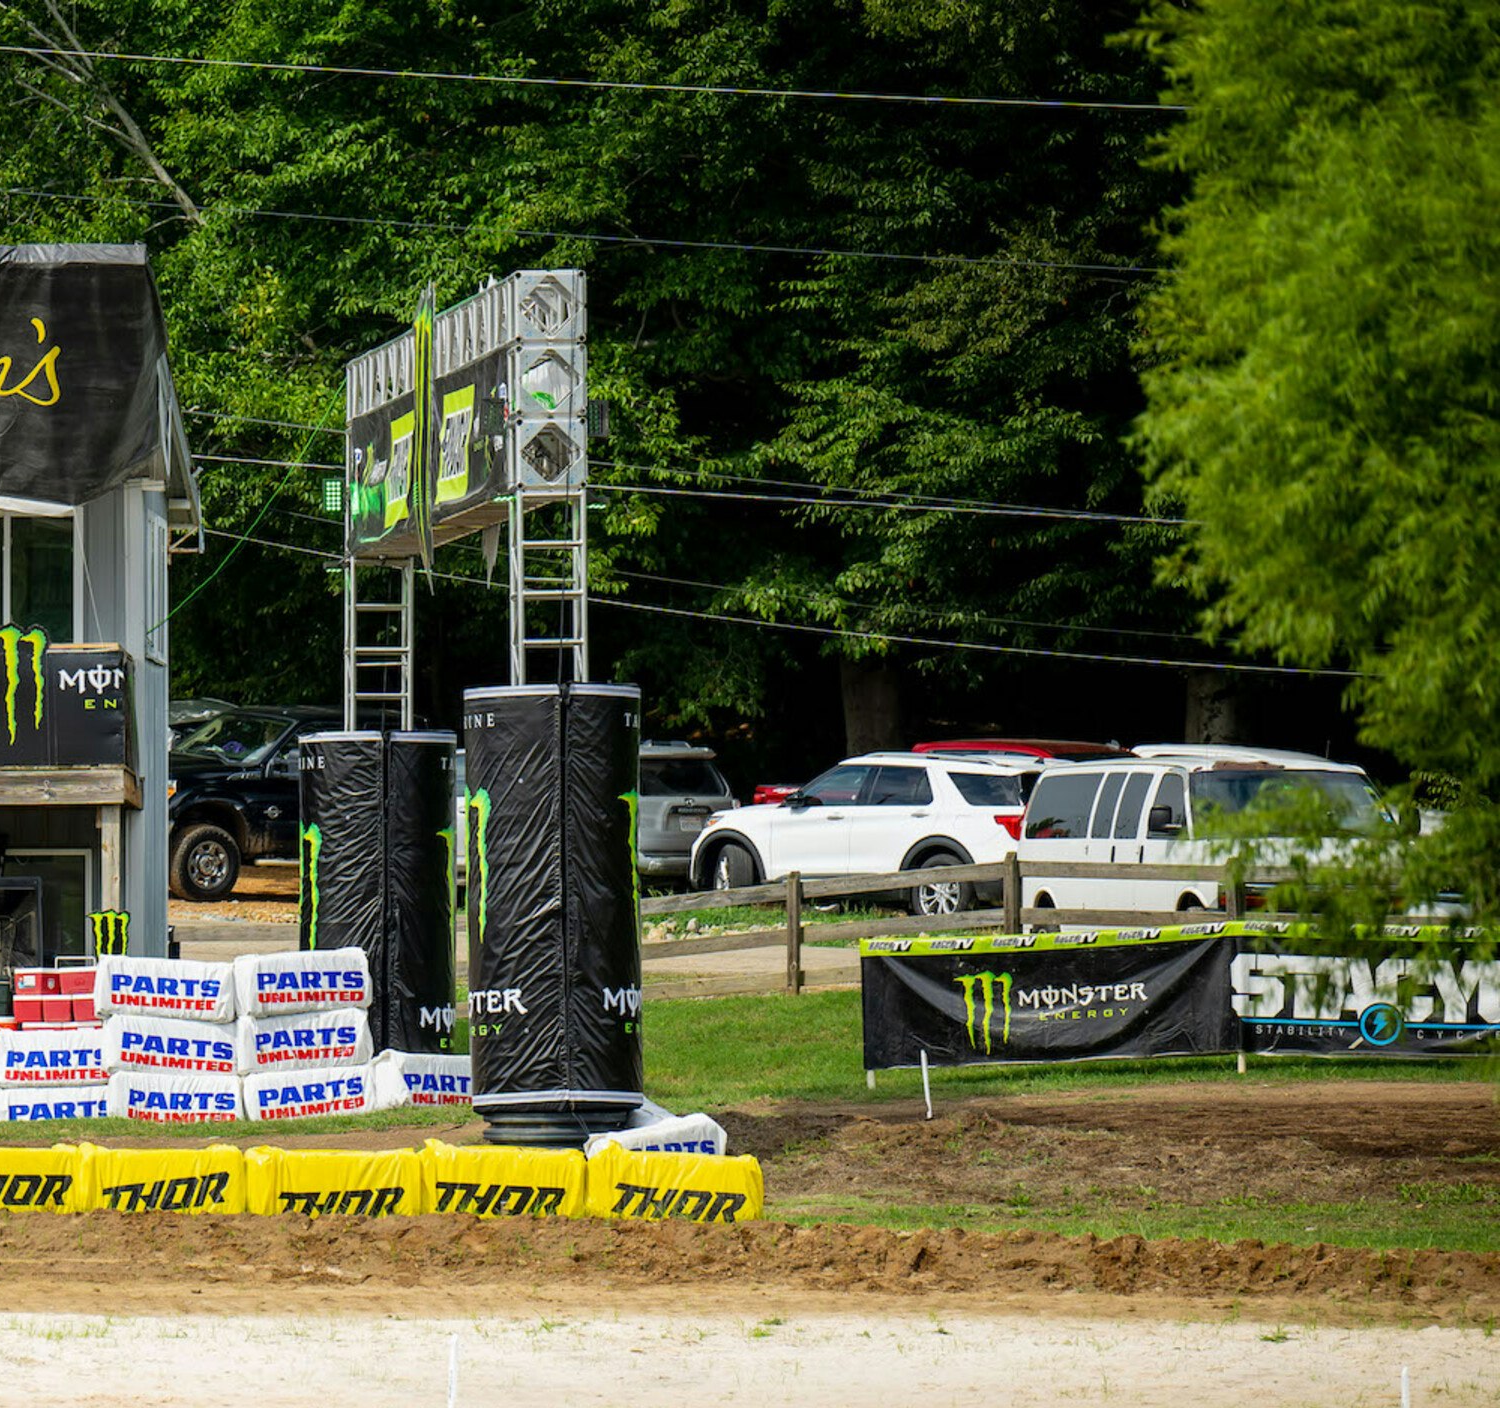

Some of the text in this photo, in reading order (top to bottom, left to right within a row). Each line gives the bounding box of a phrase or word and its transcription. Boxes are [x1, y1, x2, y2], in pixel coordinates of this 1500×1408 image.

[111, 973, 222, 998] PARTS
[257, 971, 365, 991] PARTS
[258, 991, 365, 1004] UNLIMITED
[1017, 982, 1149, 1010] MONSTER
[1038, 1007, 1129, 1021] ENERGY
[255, 1026, 357, 1051] PARTS
[1255, 1024, 1346, 1036] STABILITY
[121, 1031, 234, 1060] PARTS
[256, 1045, 356, 1065] UNLIMITED
[120, 1051, 234, 1073] UNLIMITED
[258, 1076, 364, 1107] PARTS
[403, 1073, 471, 1093] PART
[128, 1088, 236, 1110] PARTS
[260, 1095, 366, 1120] UNLIMITED
[102, 1171, 230, 1212] THOR
[611, 1182, 748, 1223] THOR
